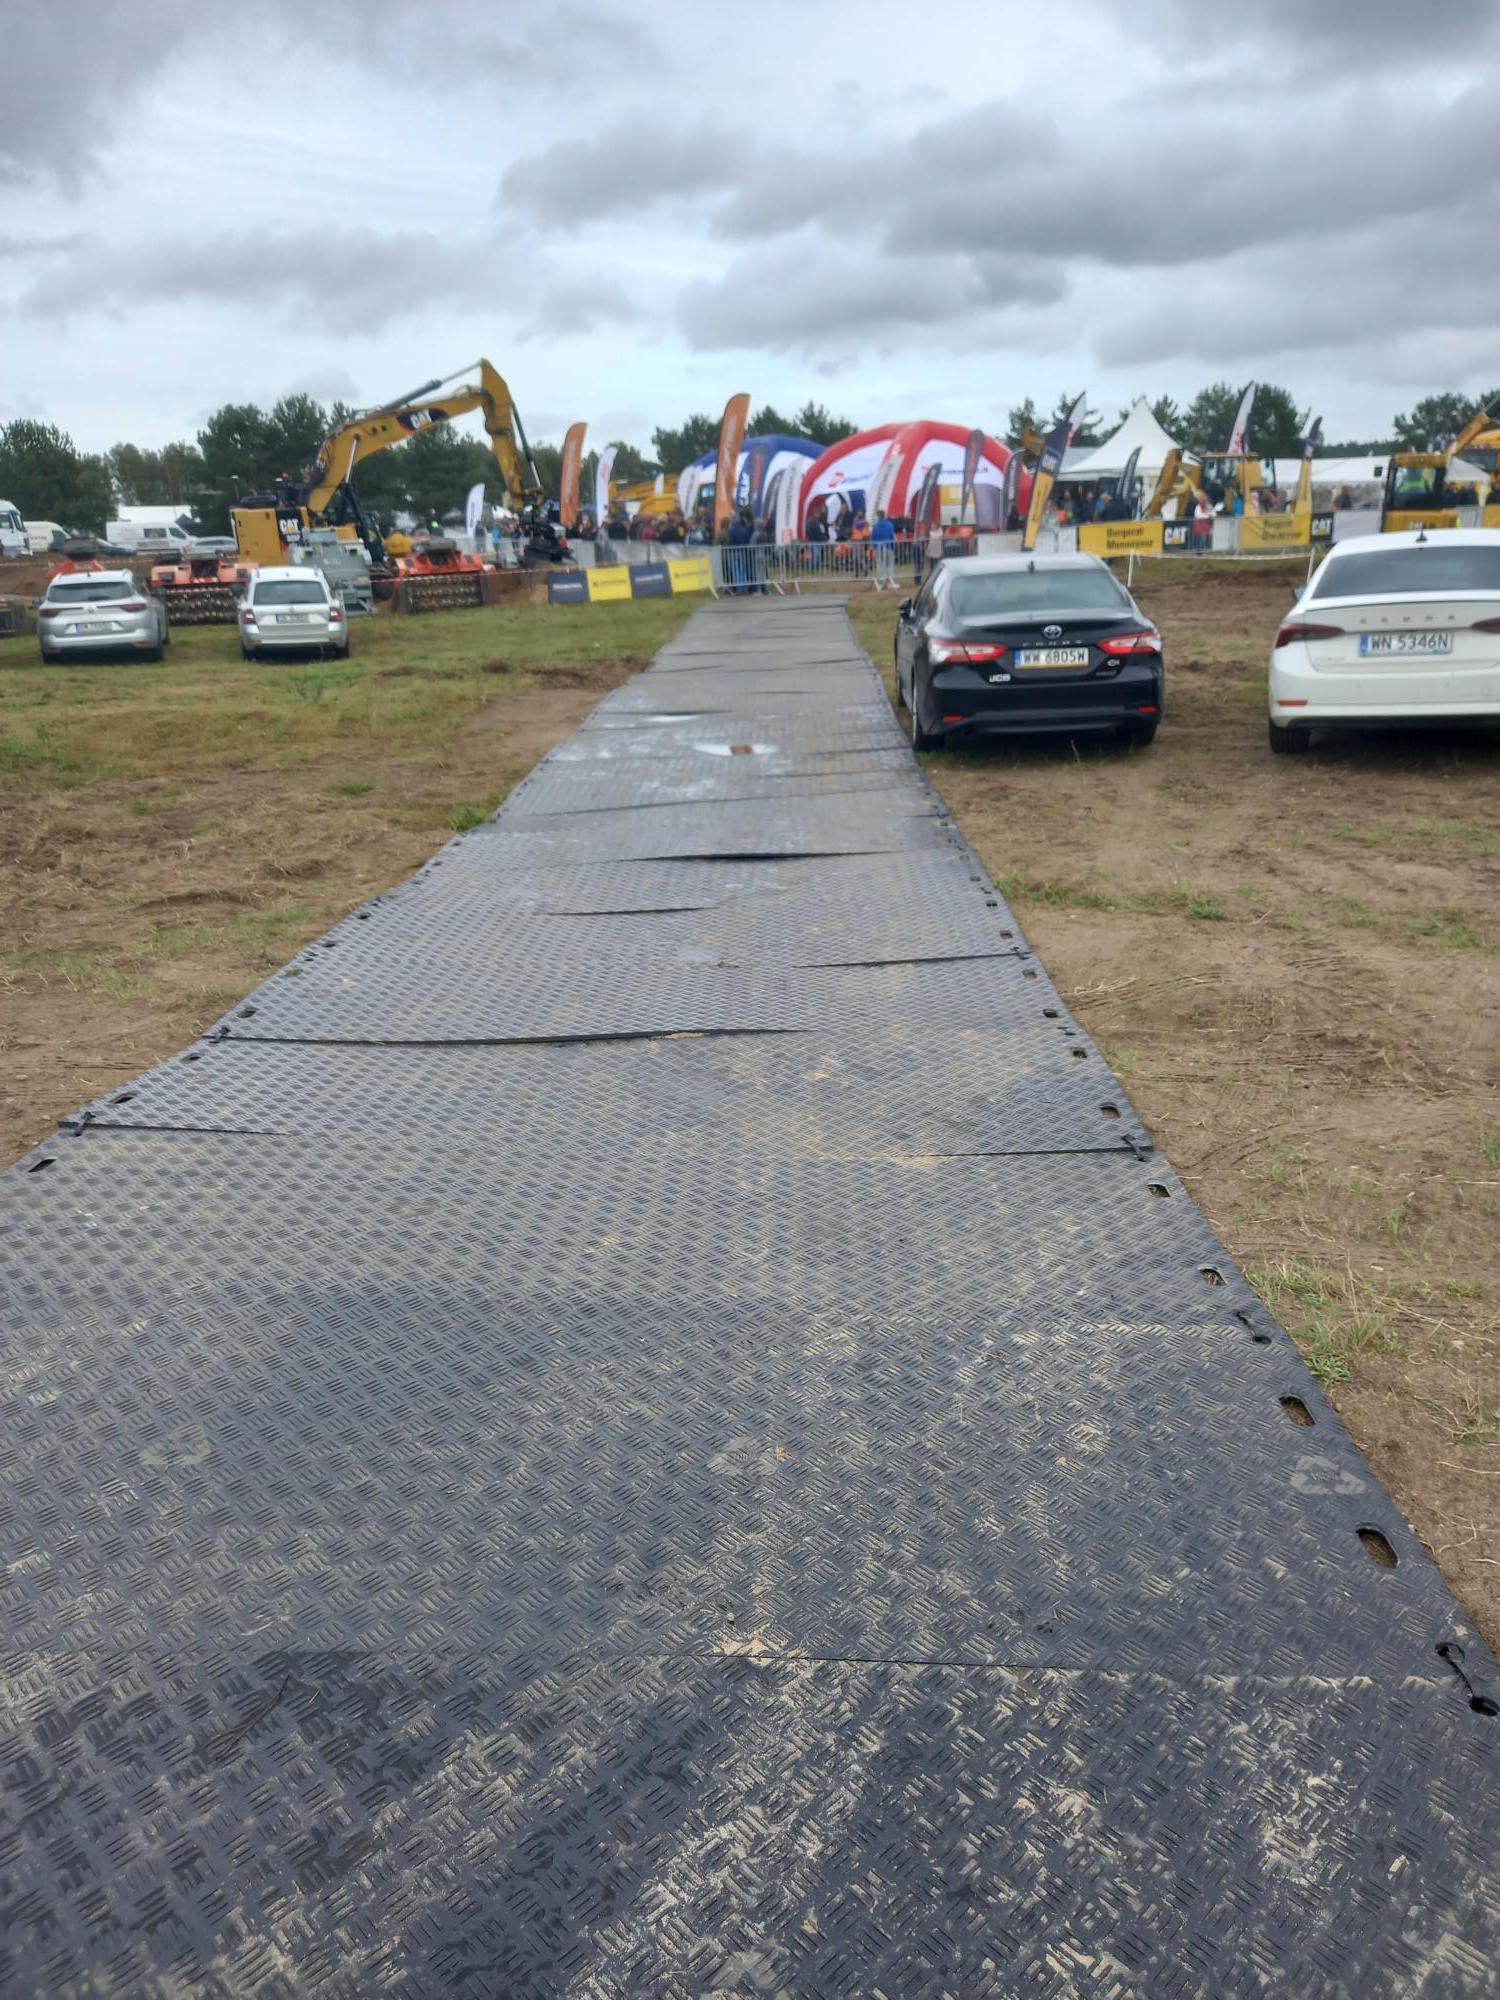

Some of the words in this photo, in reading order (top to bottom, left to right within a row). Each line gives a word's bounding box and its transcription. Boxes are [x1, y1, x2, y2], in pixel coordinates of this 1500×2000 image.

[410, 409, 432, 429] CAT
[280, 518, 300, 534] CAT
[1312, 518, 1333, 536] CAT
[1164, 526, 1188, 545] CAT
[1371, 635, 1392, 650] WN
[1398, 631, 1449, 650] 5346N
[989, 673, 1011, 682] JCB
